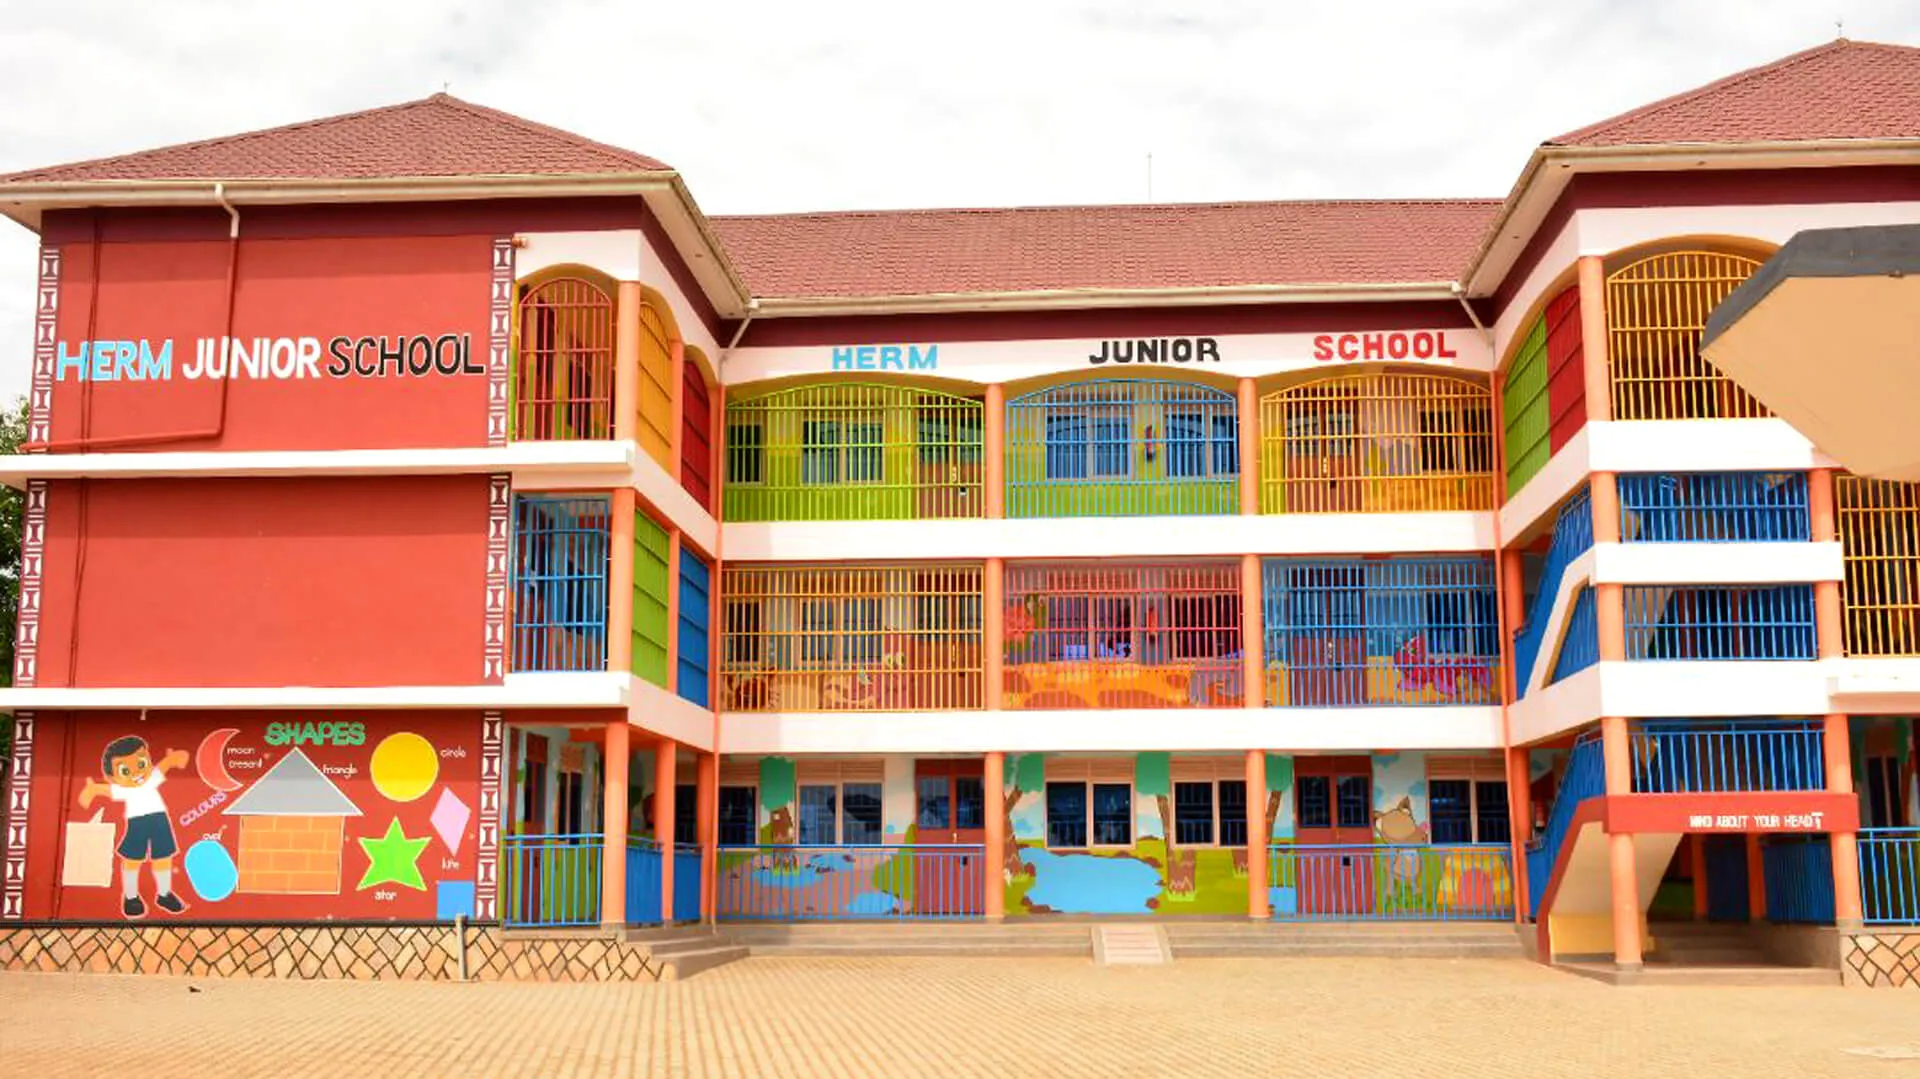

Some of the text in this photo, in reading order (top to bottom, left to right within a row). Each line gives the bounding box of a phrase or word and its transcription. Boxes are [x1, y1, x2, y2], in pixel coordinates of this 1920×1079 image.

[55, 332, 487, 382] HERM JUNIOR SCHOOL
[832, 331, 1457, 371] HERM JUNIOR SCHOOL
[263, 721, 367, 746] SHAPES
[179, 790, 228, 828] COLOURS
[1716, 815, 1749, 829] ABOUT
[1753, 815, 1781, 828] YOUR
